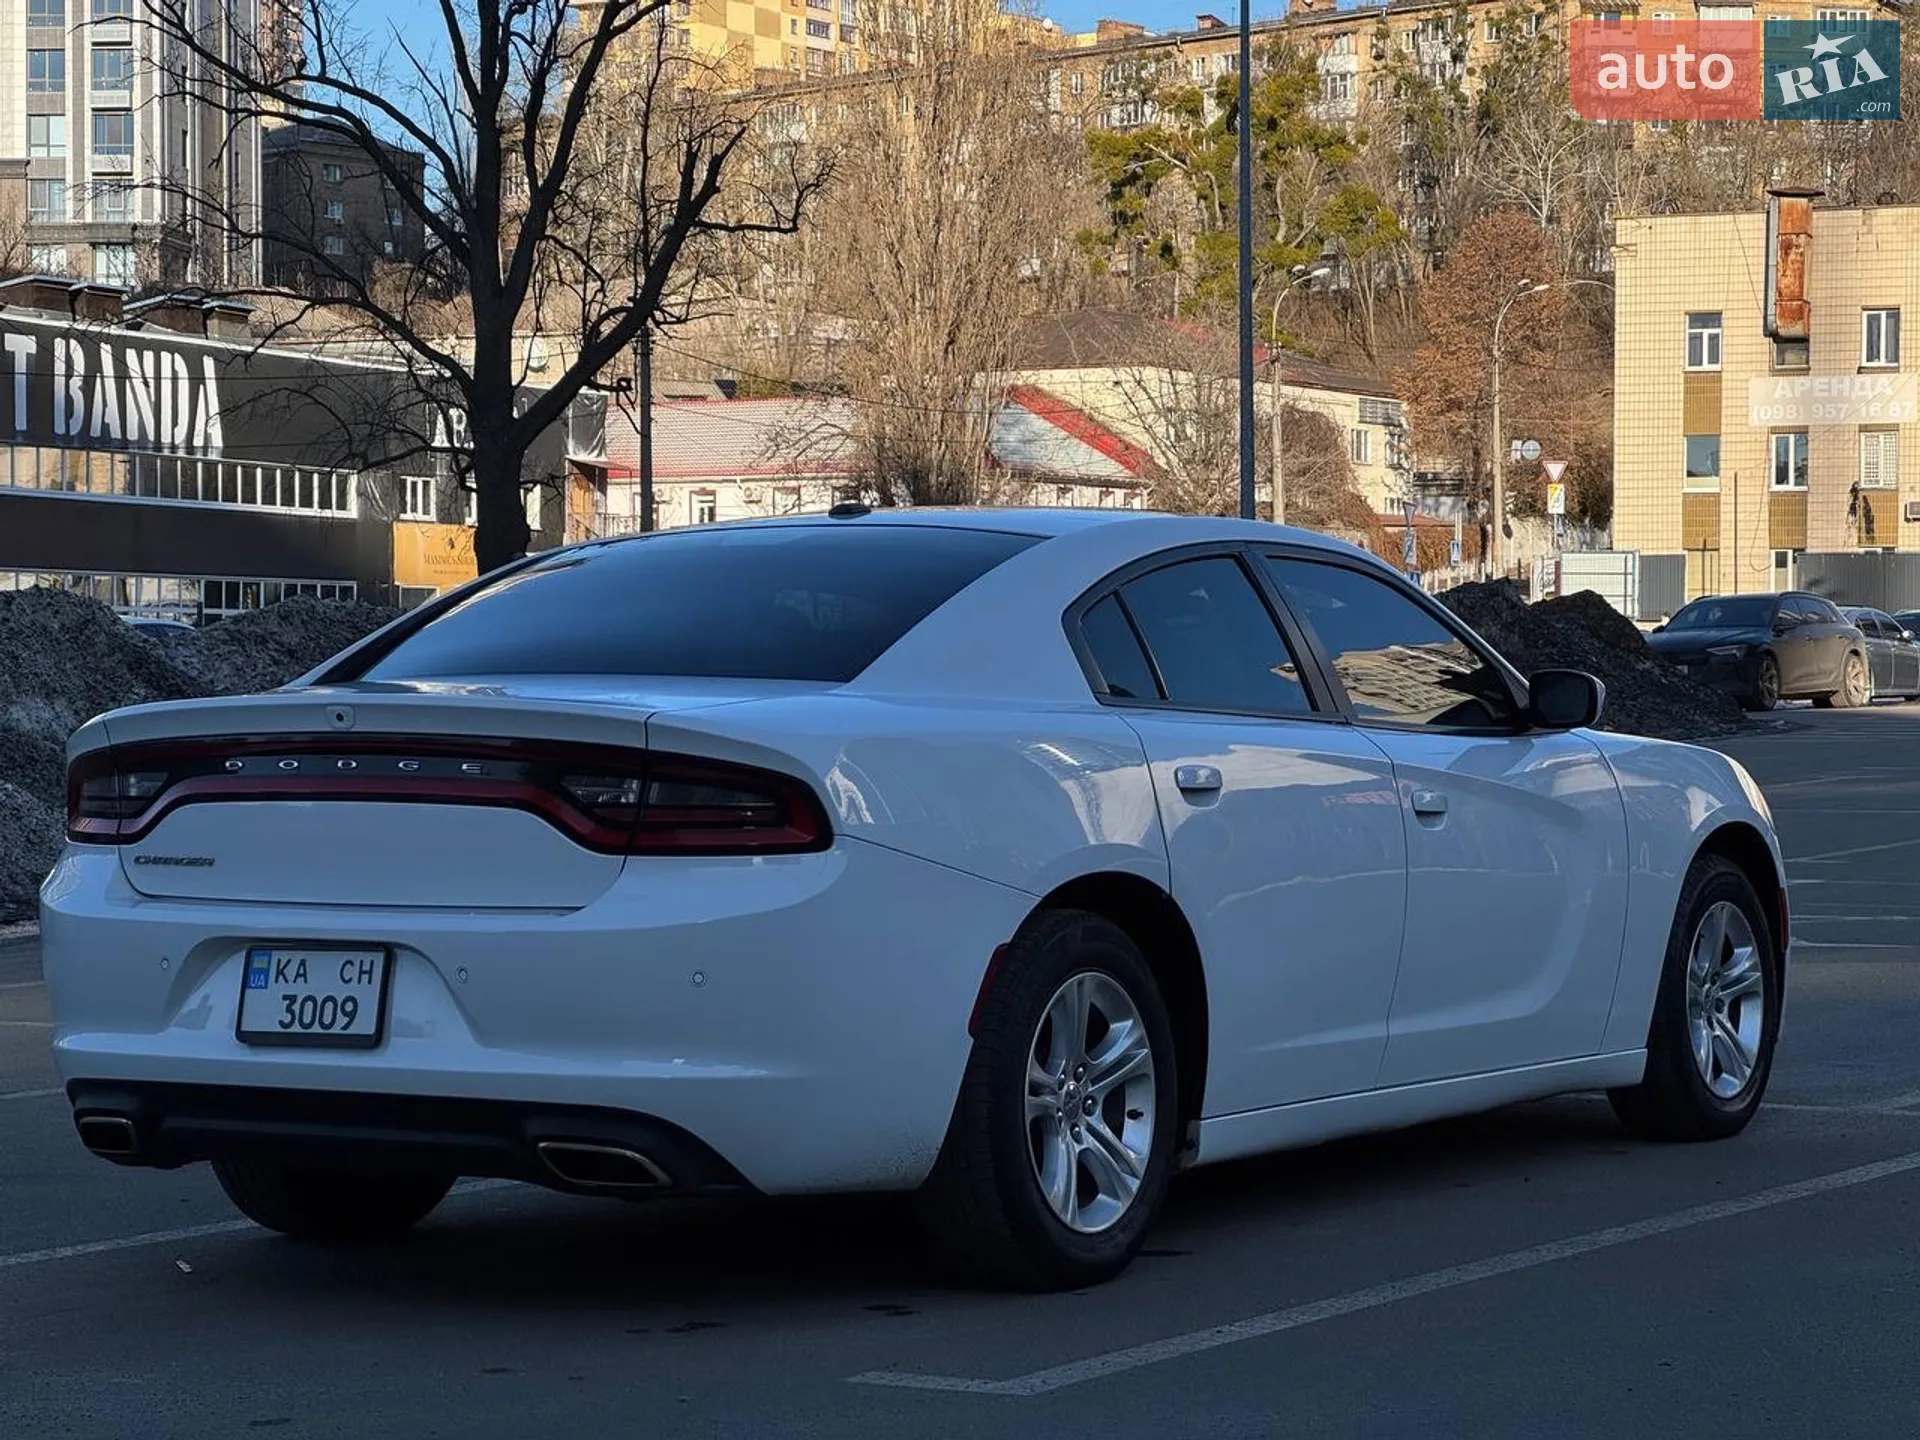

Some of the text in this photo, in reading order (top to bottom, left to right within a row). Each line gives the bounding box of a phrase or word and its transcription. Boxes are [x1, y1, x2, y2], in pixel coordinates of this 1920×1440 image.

[4, 333, 224, 447] T BANDA
[1774, 375, 1895, 400] АРЕНДА
[1812, 402, 1850, 421] 957
[1888, 400, 1914, 417] 87
[225, 756, 483, 774] DODGE
[250, 973, 266, 987] UA
[274, 958, 375, 985] KA CH
[277, 994, 359, 1031] 3009
